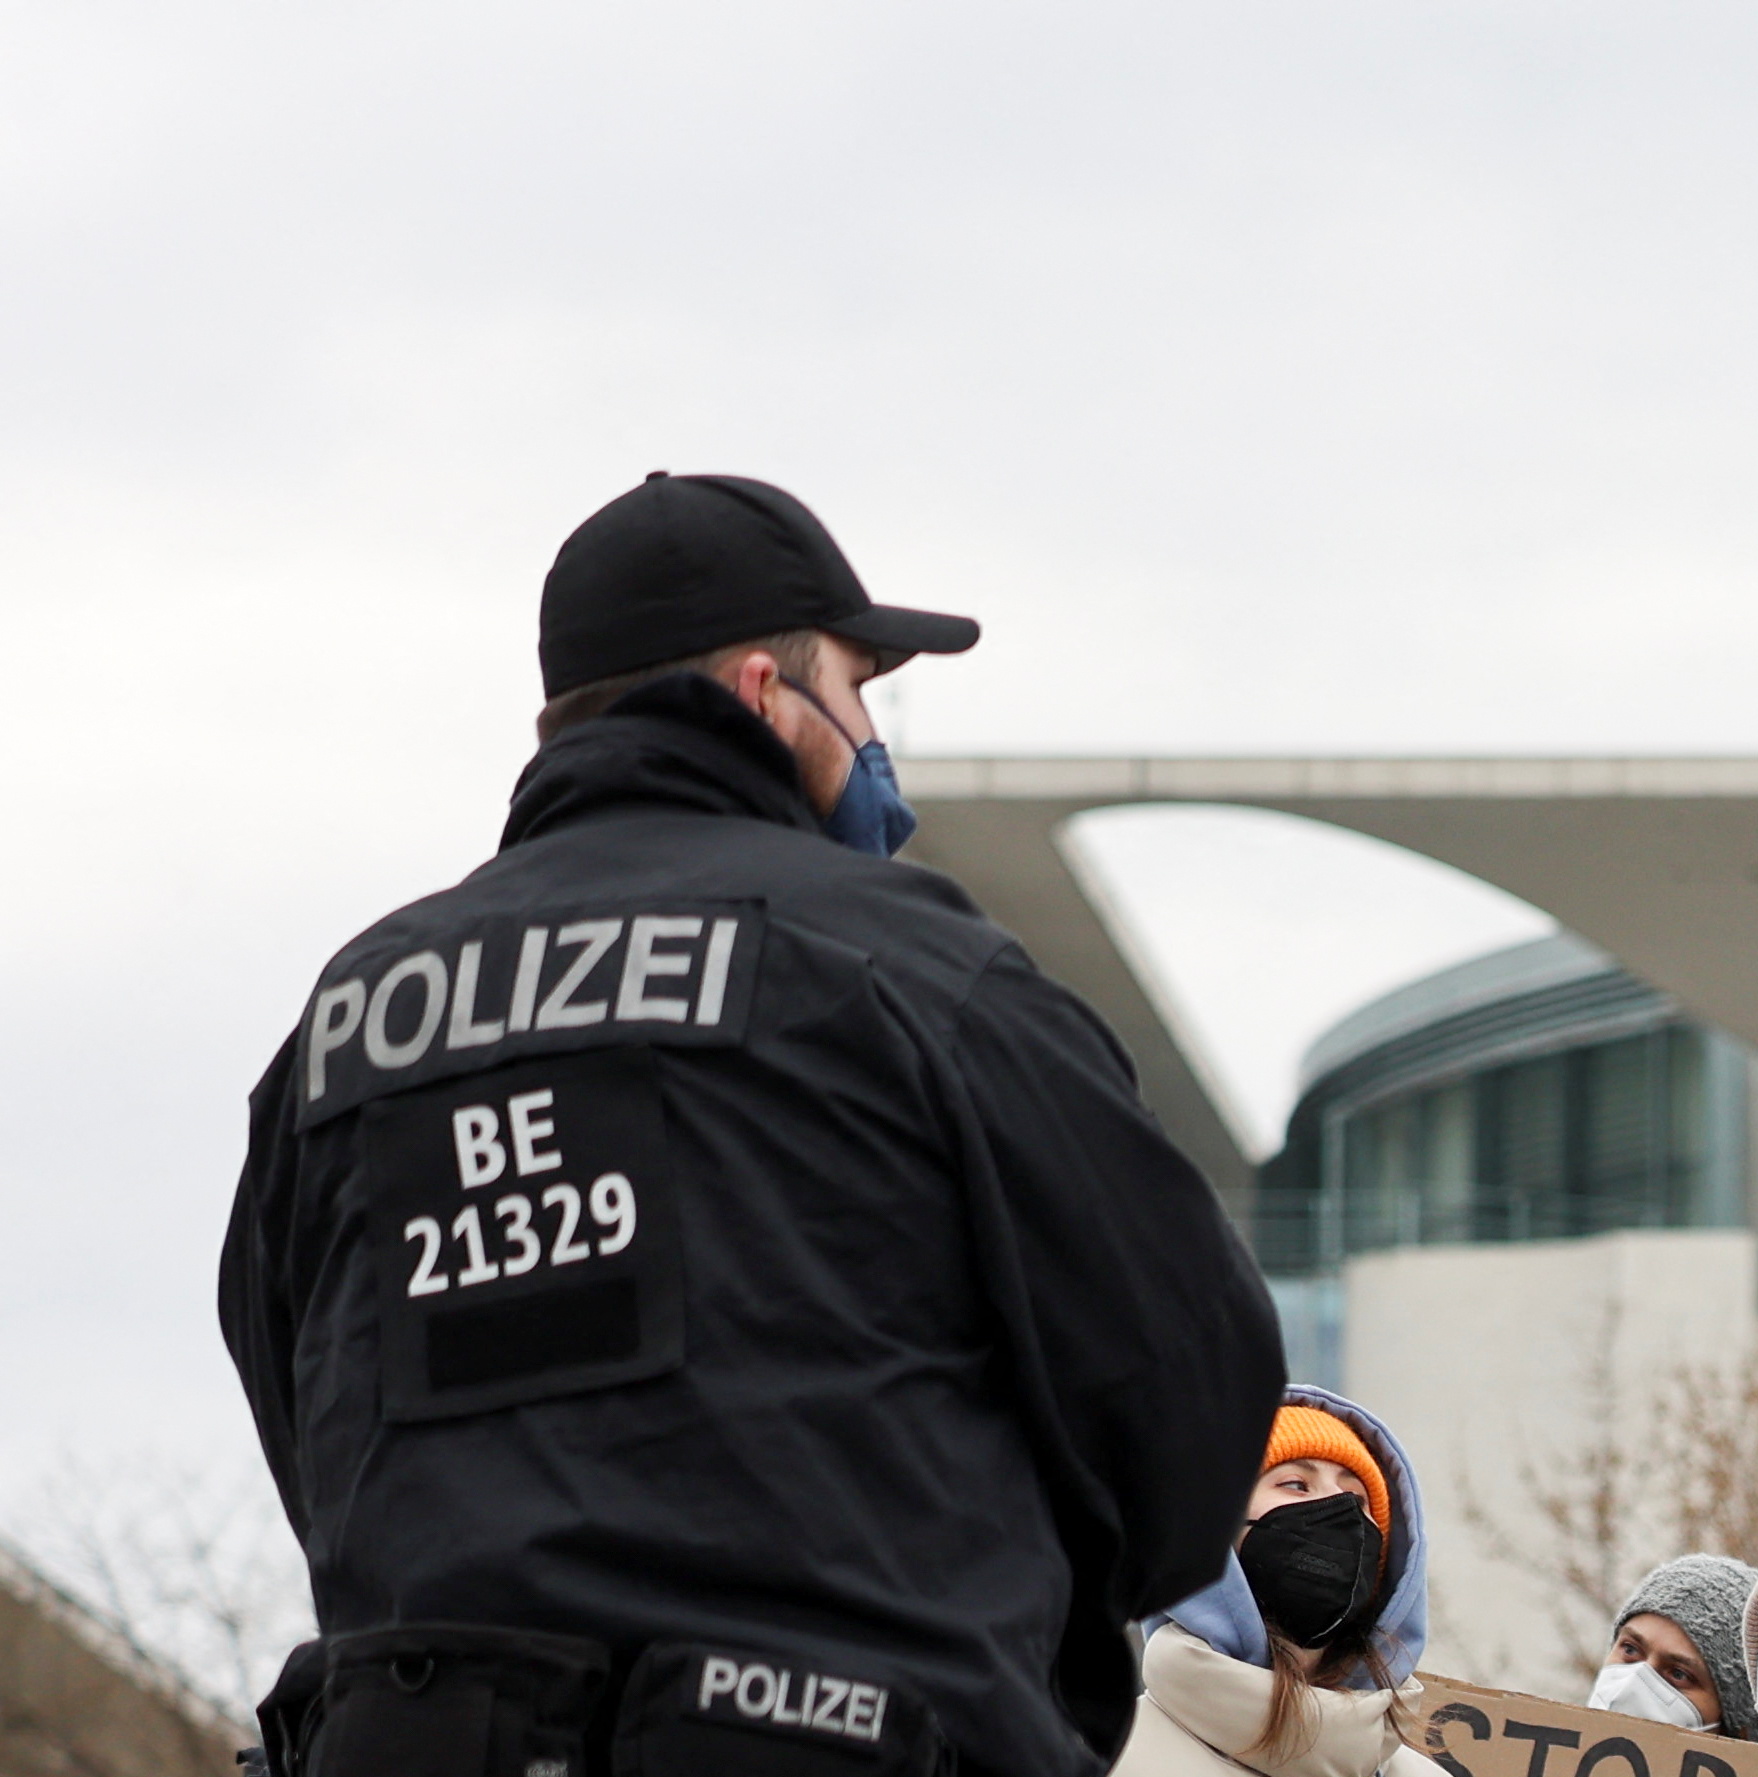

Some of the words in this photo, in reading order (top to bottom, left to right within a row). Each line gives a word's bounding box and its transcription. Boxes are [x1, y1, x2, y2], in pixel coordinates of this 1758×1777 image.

[308, 916, 738, 1103] POLIZEI
[452, 1088, 563, 1190] BE
[404, 1172, 637, 1297] 21329
[699, 1655, 889, 1742] POLIZEI
